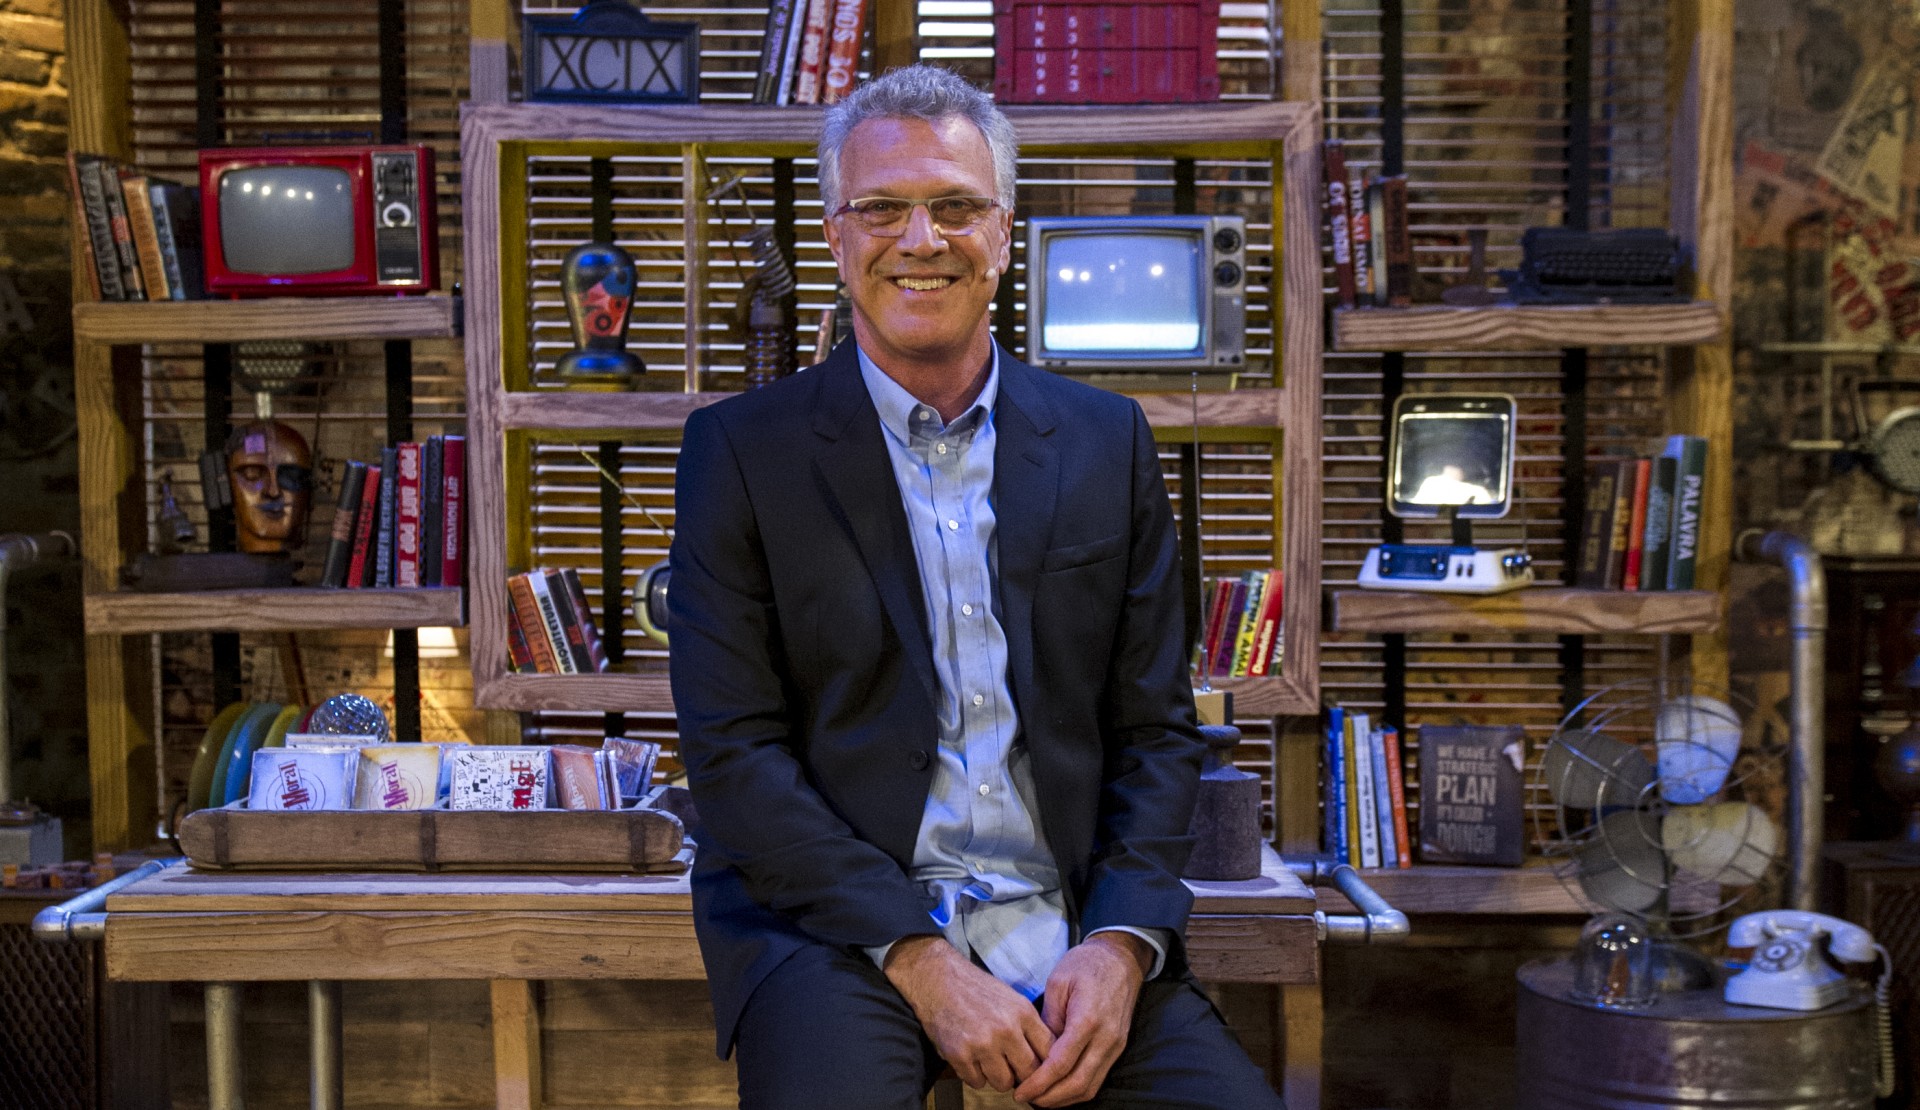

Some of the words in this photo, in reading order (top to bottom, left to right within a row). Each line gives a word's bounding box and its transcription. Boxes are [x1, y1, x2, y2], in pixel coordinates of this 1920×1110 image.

[543, 37, 681, 91] XCIX
[400, 448, 418, 480] POP
[401, 486, 418, 517] ART
[1677, 474, 1701, 560] PALAVRA
[399, 522, 417, 555] POP
[540, 595, 574, 673] ARQUITETURA
[280, 762, 310, 808] Moral
[382, 762, 409, 808] Moral
[1436, 775, 1498, 805] PLAN
